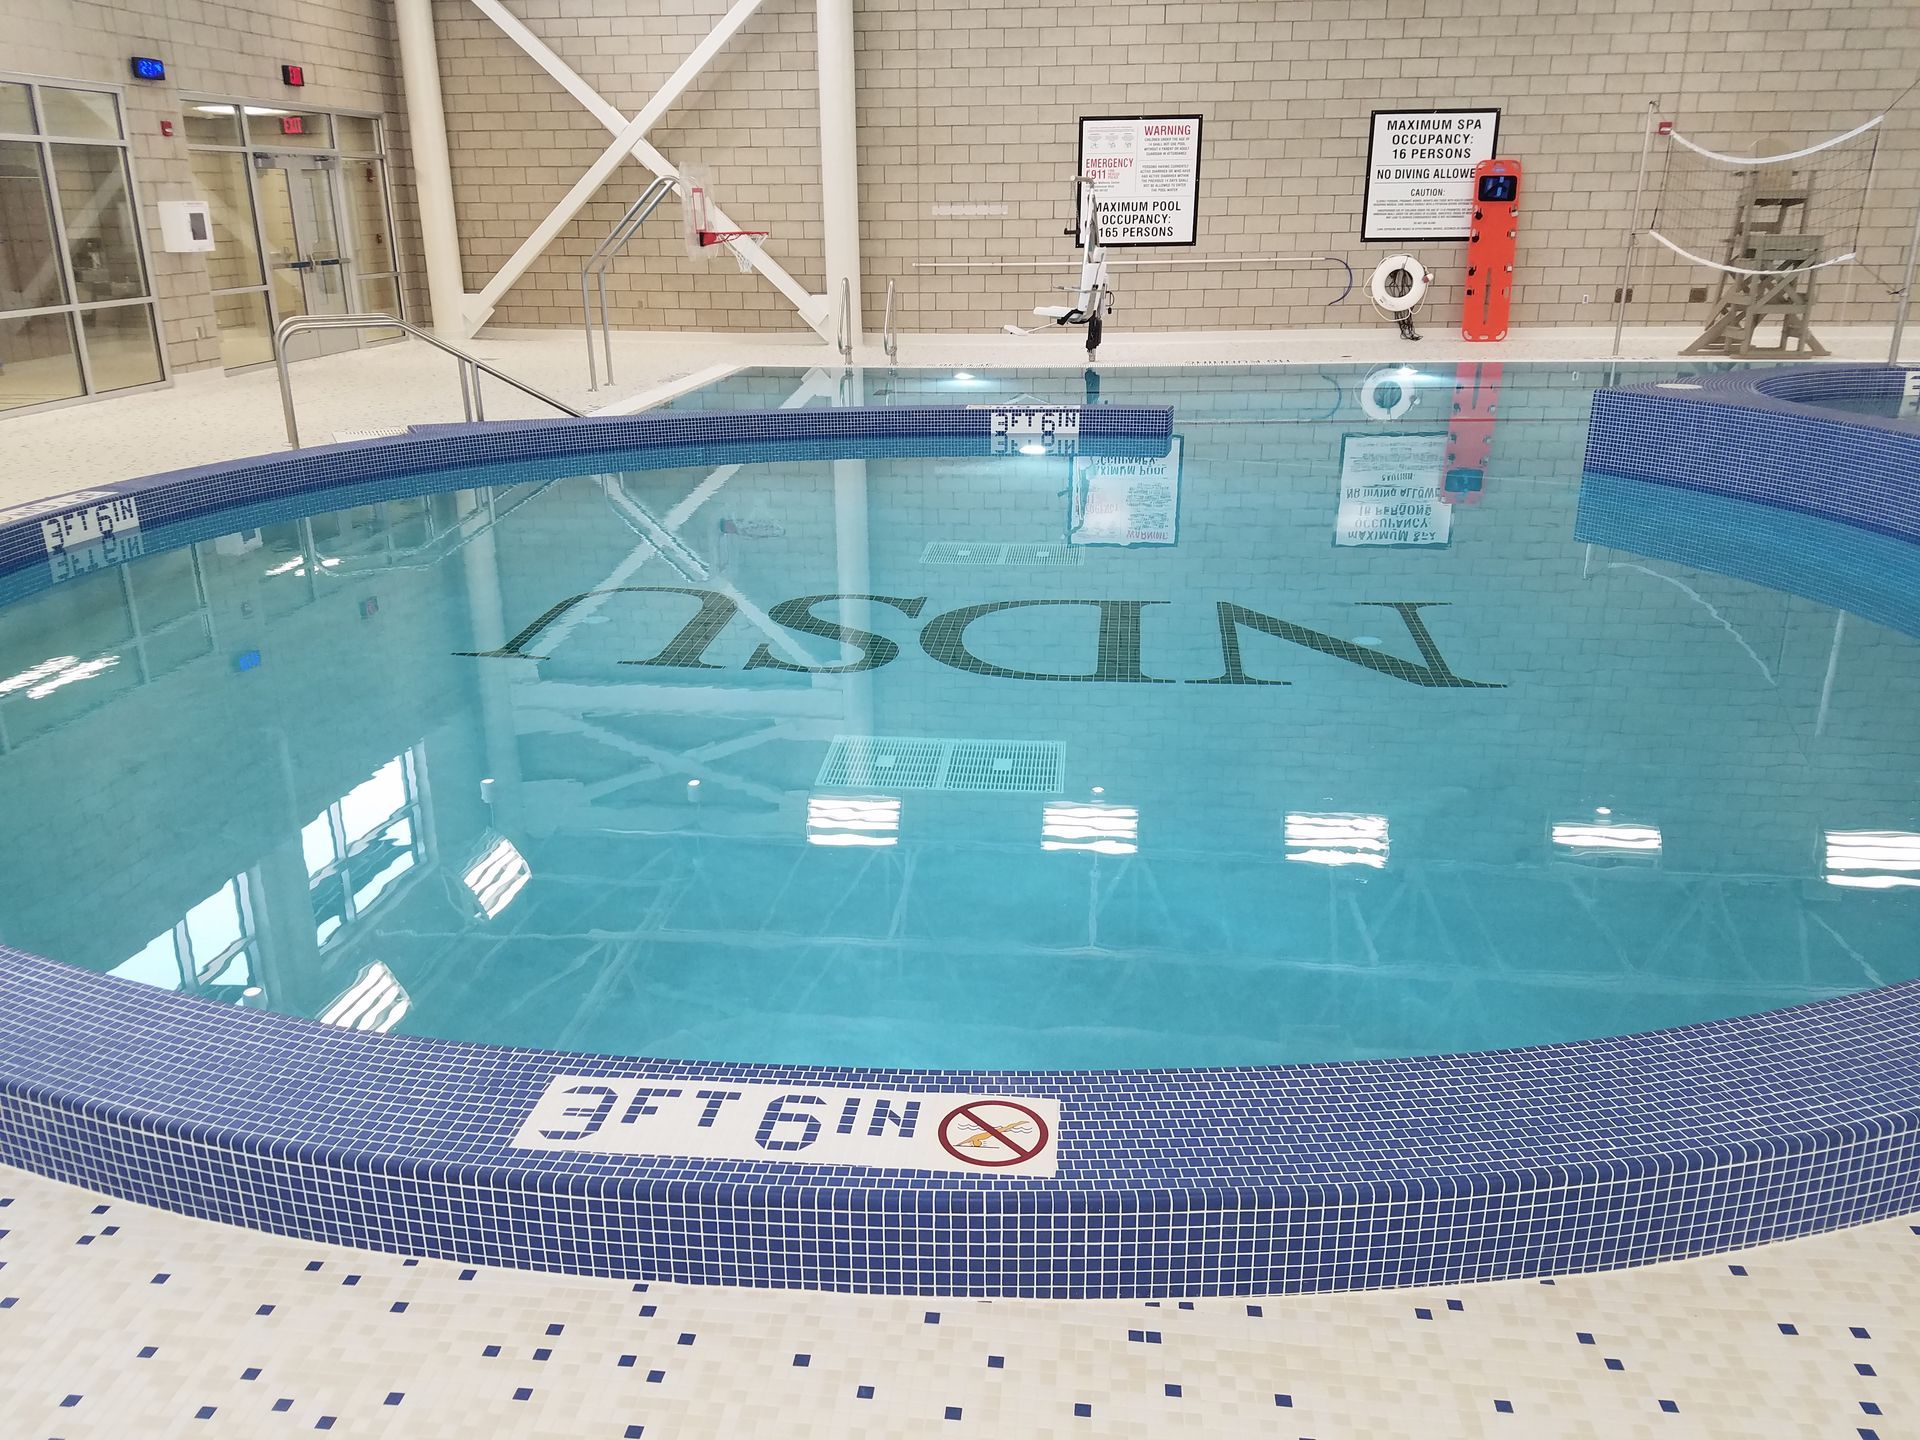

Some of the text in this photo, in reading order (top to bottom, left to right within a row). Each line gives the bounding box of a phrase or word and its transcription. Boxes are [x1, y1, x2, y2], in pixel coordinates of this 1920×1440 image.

[1387, 119, 1482, 130] MAXIMUM SPA
[1144, 125, 1191, 136] WARNING
[1392, 134, 1474, 145] OCCUPANCY:
[1392, 148, 1471, 159] 16 PERSONS
[1086, 158, 1133, 169] EMERGENCY
[1377, 168, 1475, 180] NO DIVING ALLOWE
[1410, 188, 1446, 197] CAUTION:
[1152, 201, 1181, 211] POOL
[1102, 214, 1171, 225] OCCUPANCY:
[1099, 227, 1174, 237] 165 PERSONS
[452, 587, 1508, 689] NDSU
